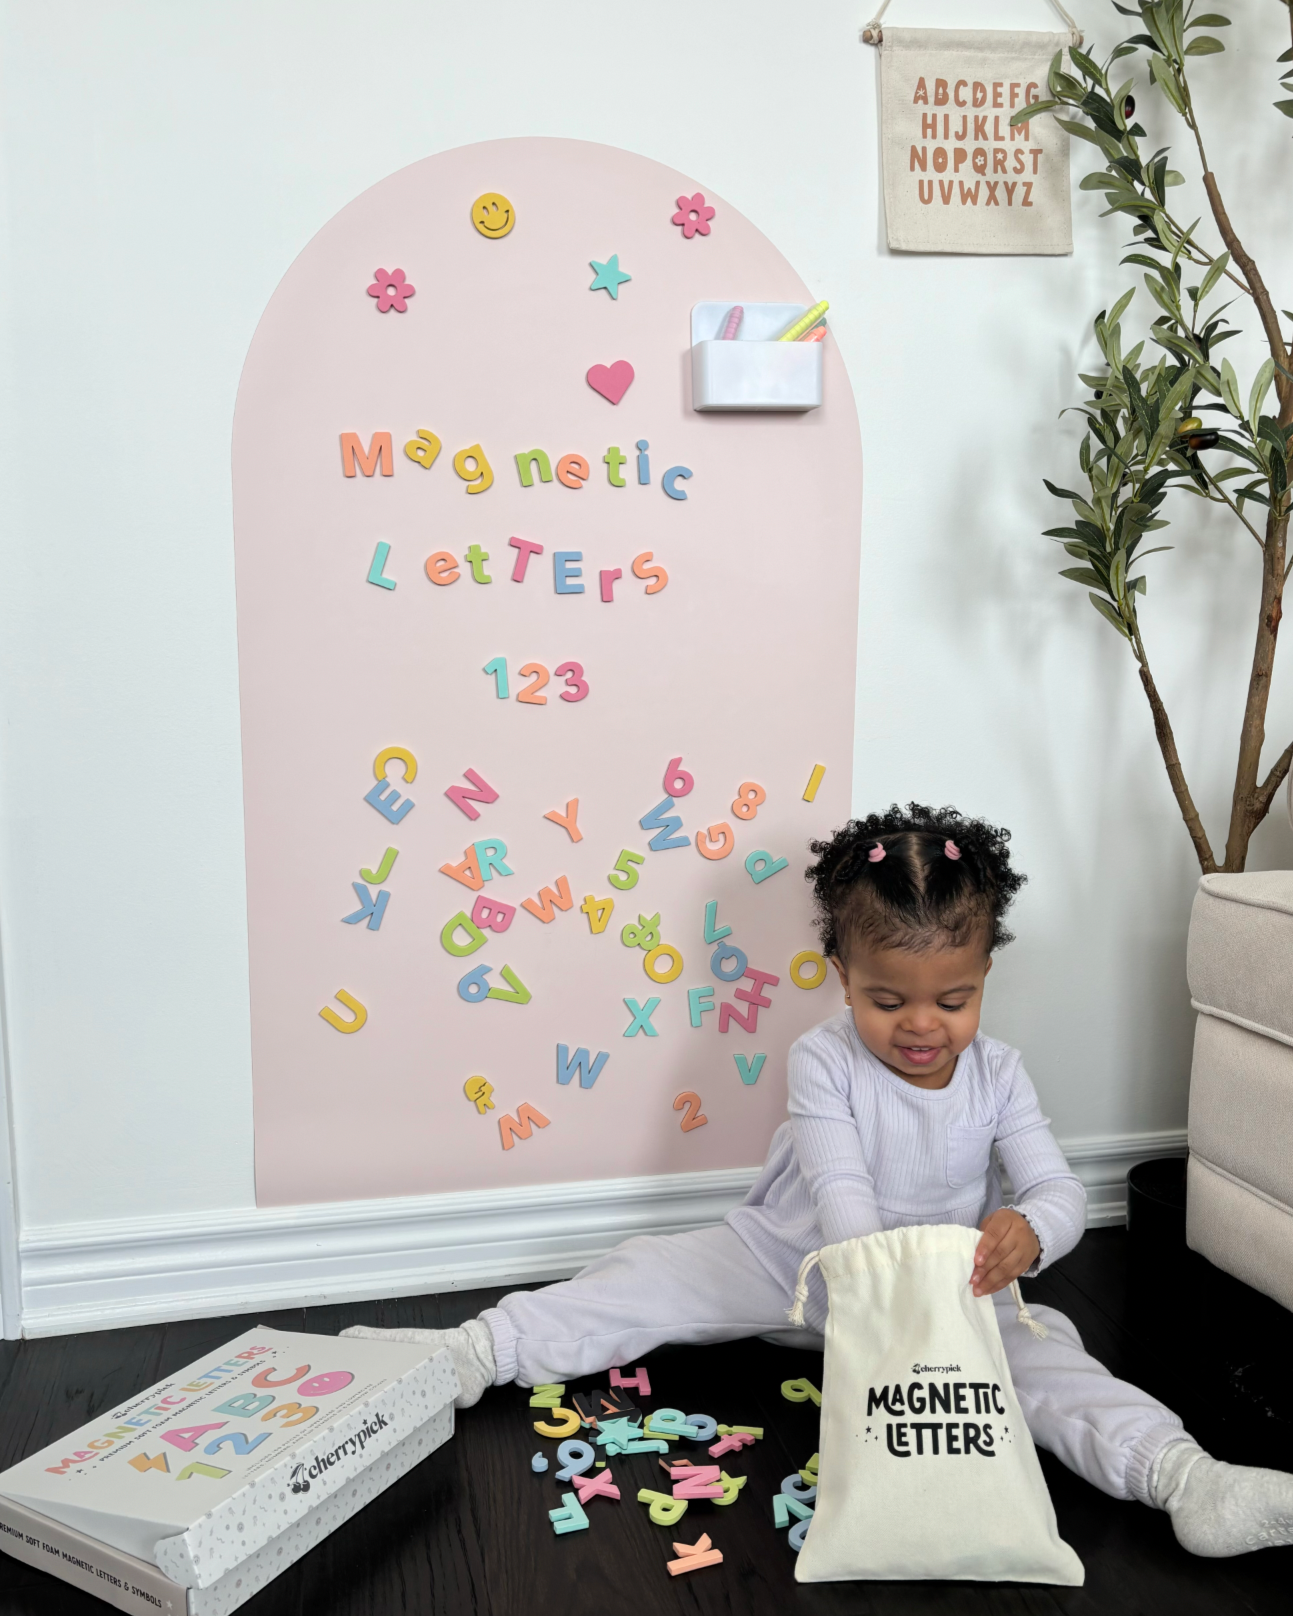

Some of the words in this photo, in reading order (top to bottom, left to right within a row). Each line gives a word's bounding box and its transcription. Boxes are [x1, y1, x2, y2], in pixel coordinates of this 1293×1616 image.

[912, 77, 1040, 109] ABCDEFG
[921, 113, 1030, 142] HIJKLM
[909, 145, 1043, 177] NOPQRST
[918, 180, 1033, 207] UVWXYZ
[340, 428, 693, 501] Magnetic
[483, 657, 590, 705] 123
[920, 1364, 962, 1374] cherrypick
[44, 1395, 187, 1475] MAGNETIC
[178, 1345, 274, 1393] LETTERS
[867, 1382, 1006, 1417] MAGNETIC
[308, 1412, 389, 1480] cherrypick
[886, 1422, 996, 1458] LETTERS
[25, 1534, 40, 1549] SOFT
[42, 1542, 61, 1558] FOAM
[62, 1551, 95, 1574] MAGNETIC
[95, 1568, 122, 1588] LETTERS
[131, 1585, 163, 1609] SYMBOLS
